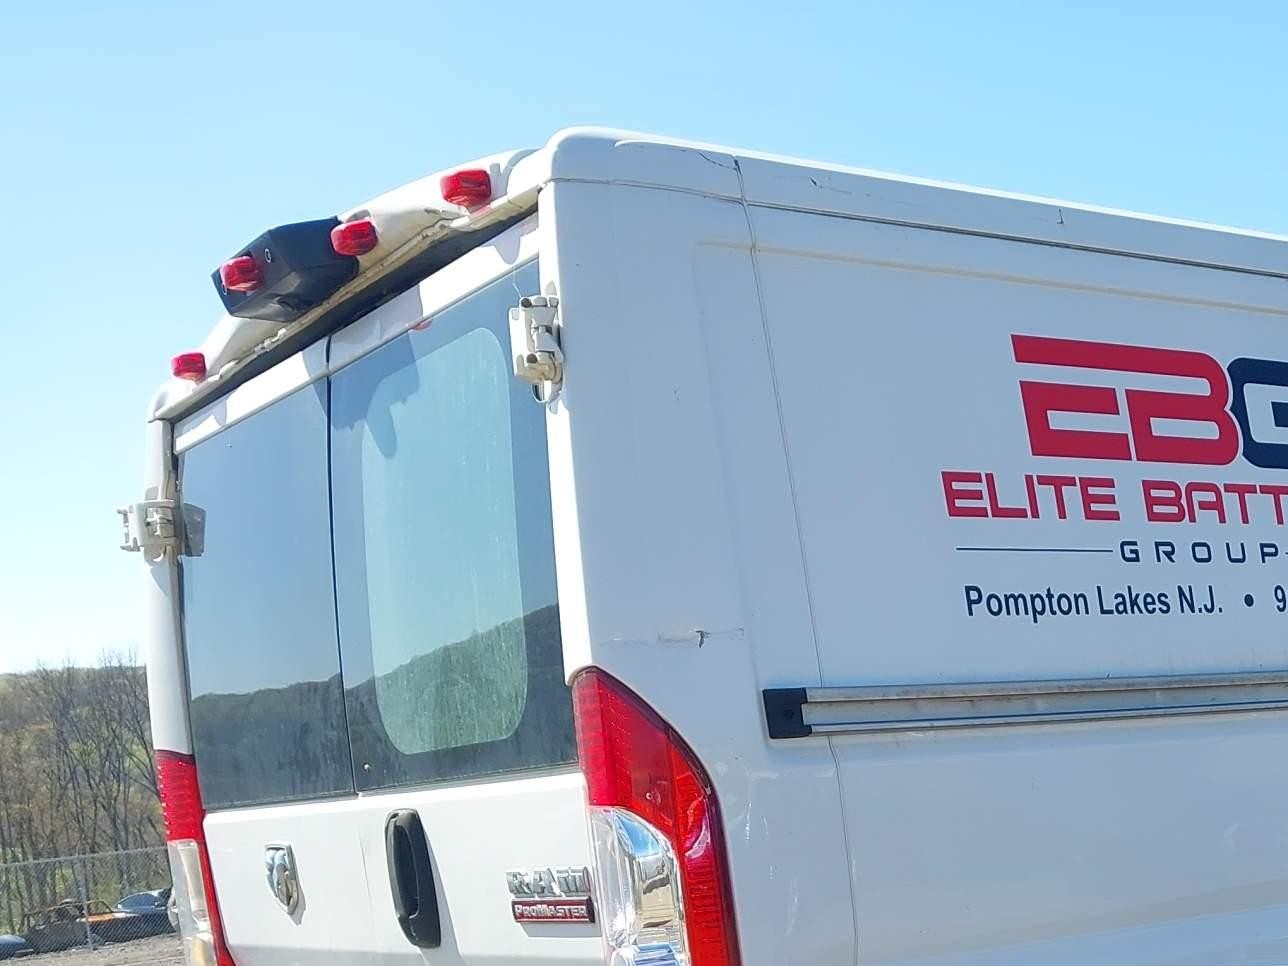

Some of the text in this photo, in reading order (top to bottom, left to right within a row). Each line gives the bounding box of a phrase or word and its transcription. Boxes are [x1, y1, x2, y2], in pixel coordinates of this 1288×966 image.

[941, 471, 1121, 522] ELITE
[1119, 540, 1280, 564] GROUP
[964, 585, 1093, 624] Pompton
[1096, 586, 1172, 616] Lakes
[1178, 586, 1224, 615] N.J.
